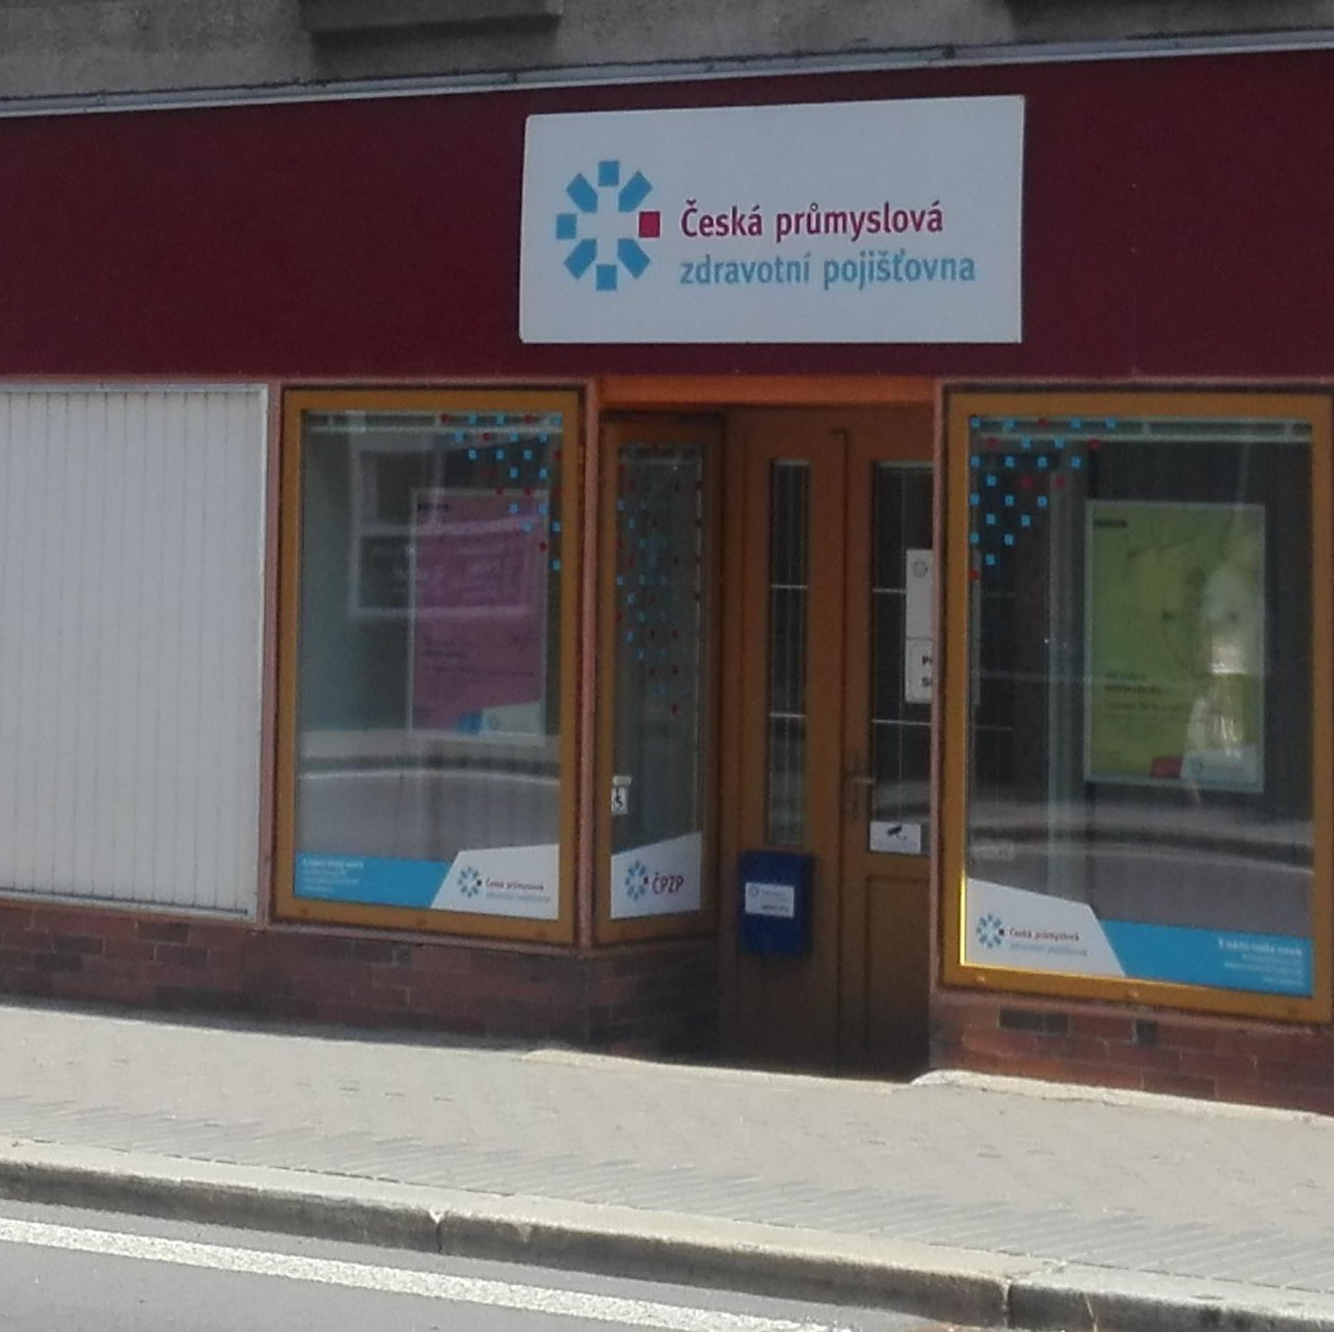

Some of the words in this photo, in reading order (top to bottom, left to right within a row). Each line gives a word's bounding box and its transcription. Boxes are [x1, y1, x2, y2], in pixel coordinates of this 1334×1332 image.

[680, 200, 763, 237] Česká
[776, 200, 944, 242] průmyslová
[680, 252, 812, 284] zdravotní
[823, 248, 976, 290] pojišťovna
[652, 871, 685, 895] ČPZP
